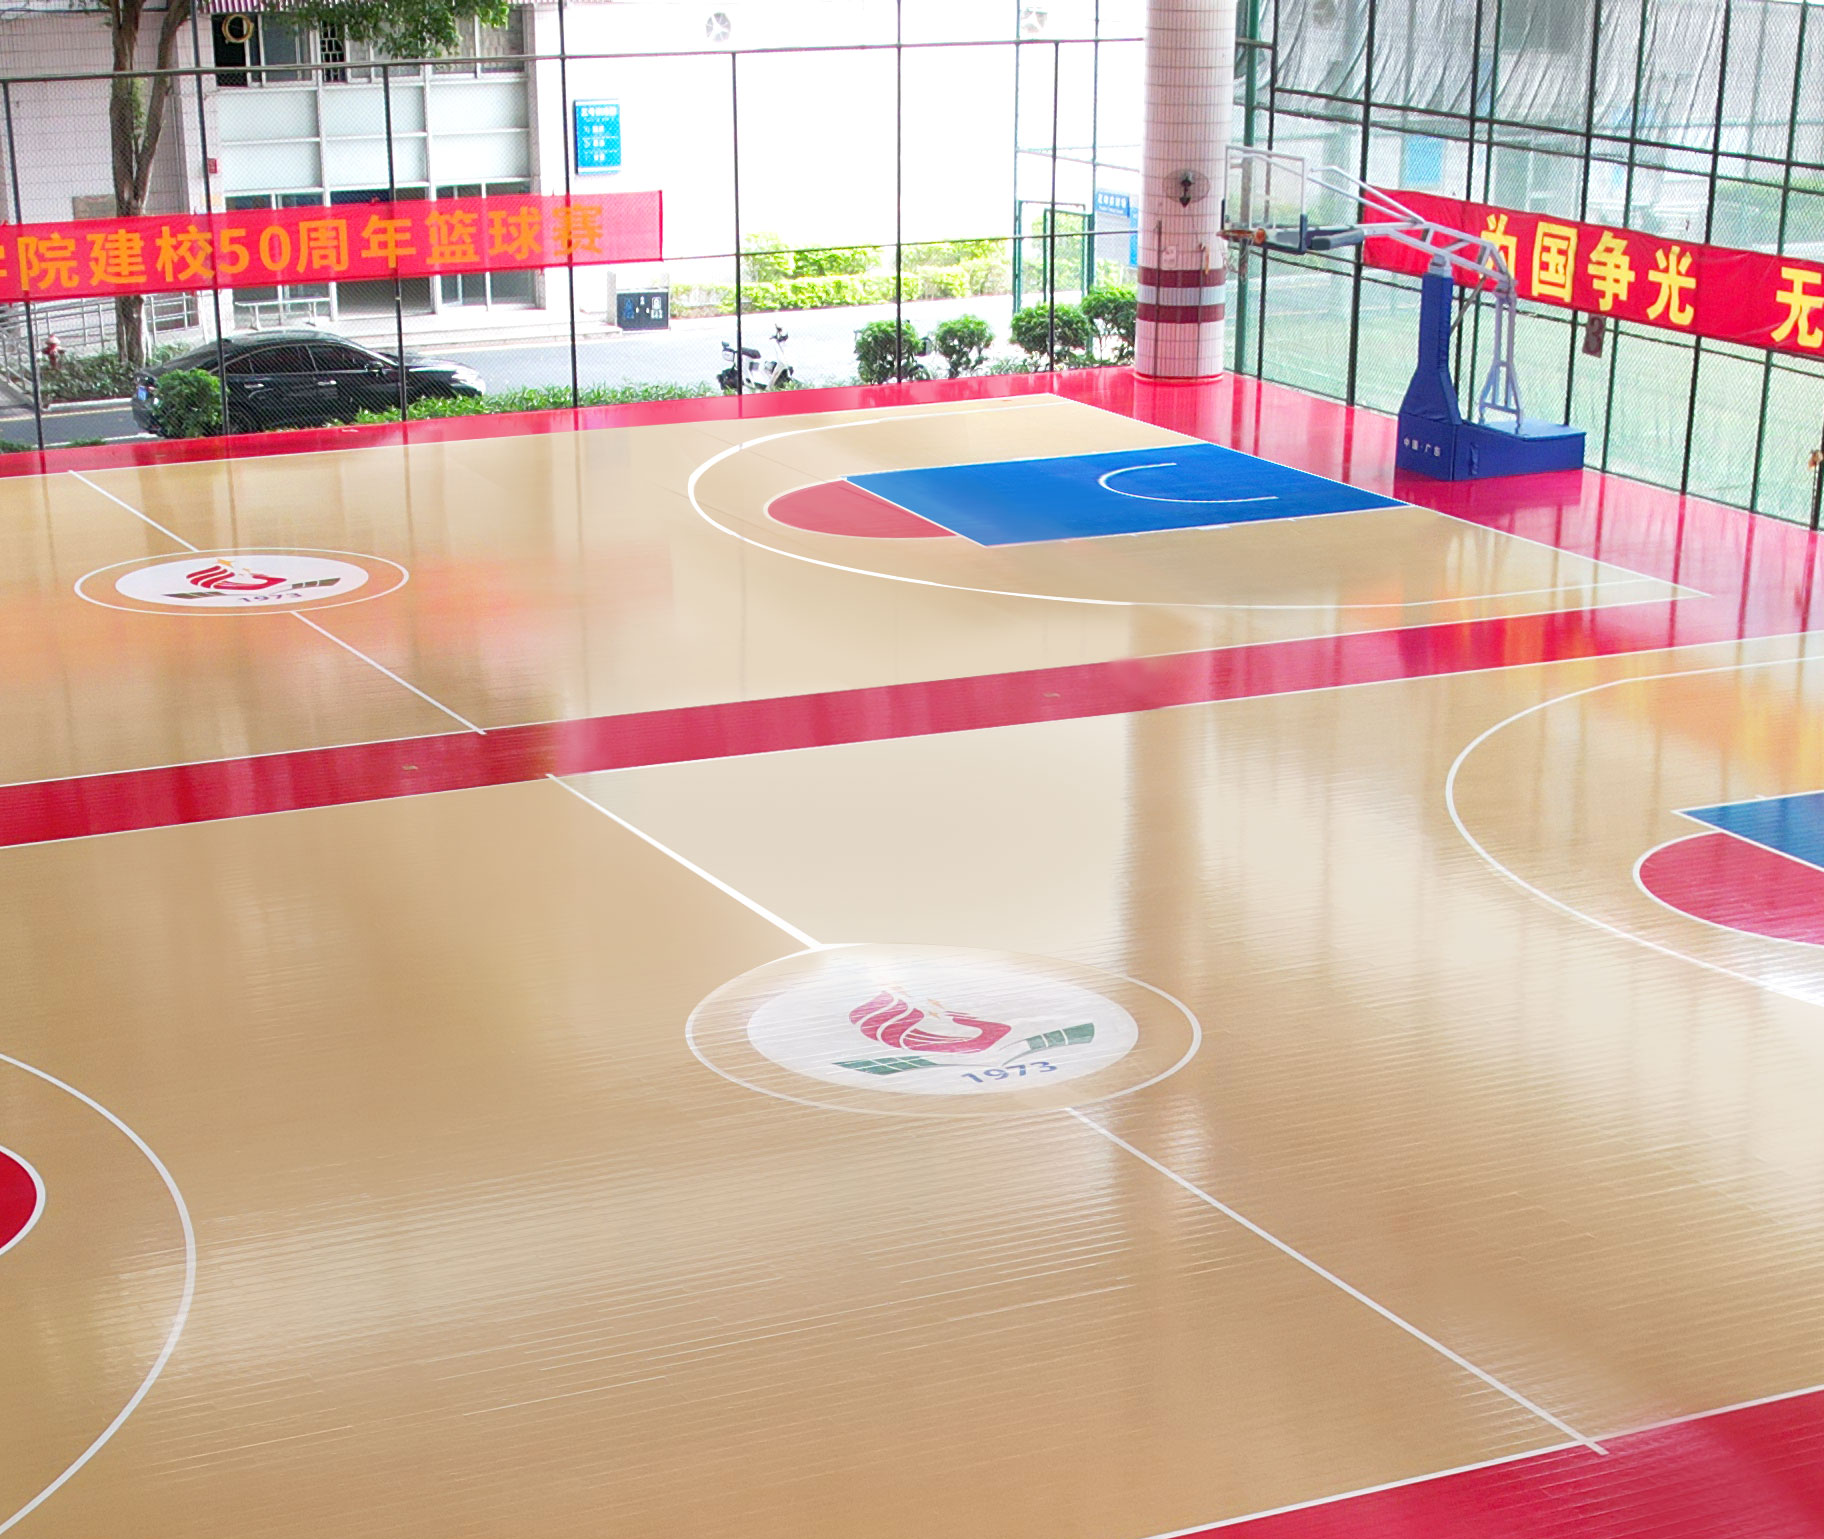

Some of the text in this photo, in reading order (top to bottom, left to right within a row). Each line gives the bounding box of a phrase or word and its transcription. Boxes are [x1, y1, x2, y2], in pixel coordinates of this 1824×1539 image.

[1479, 213, 1698, 326] 为国争光
[961, 1061, 1058, 1083] 1973
